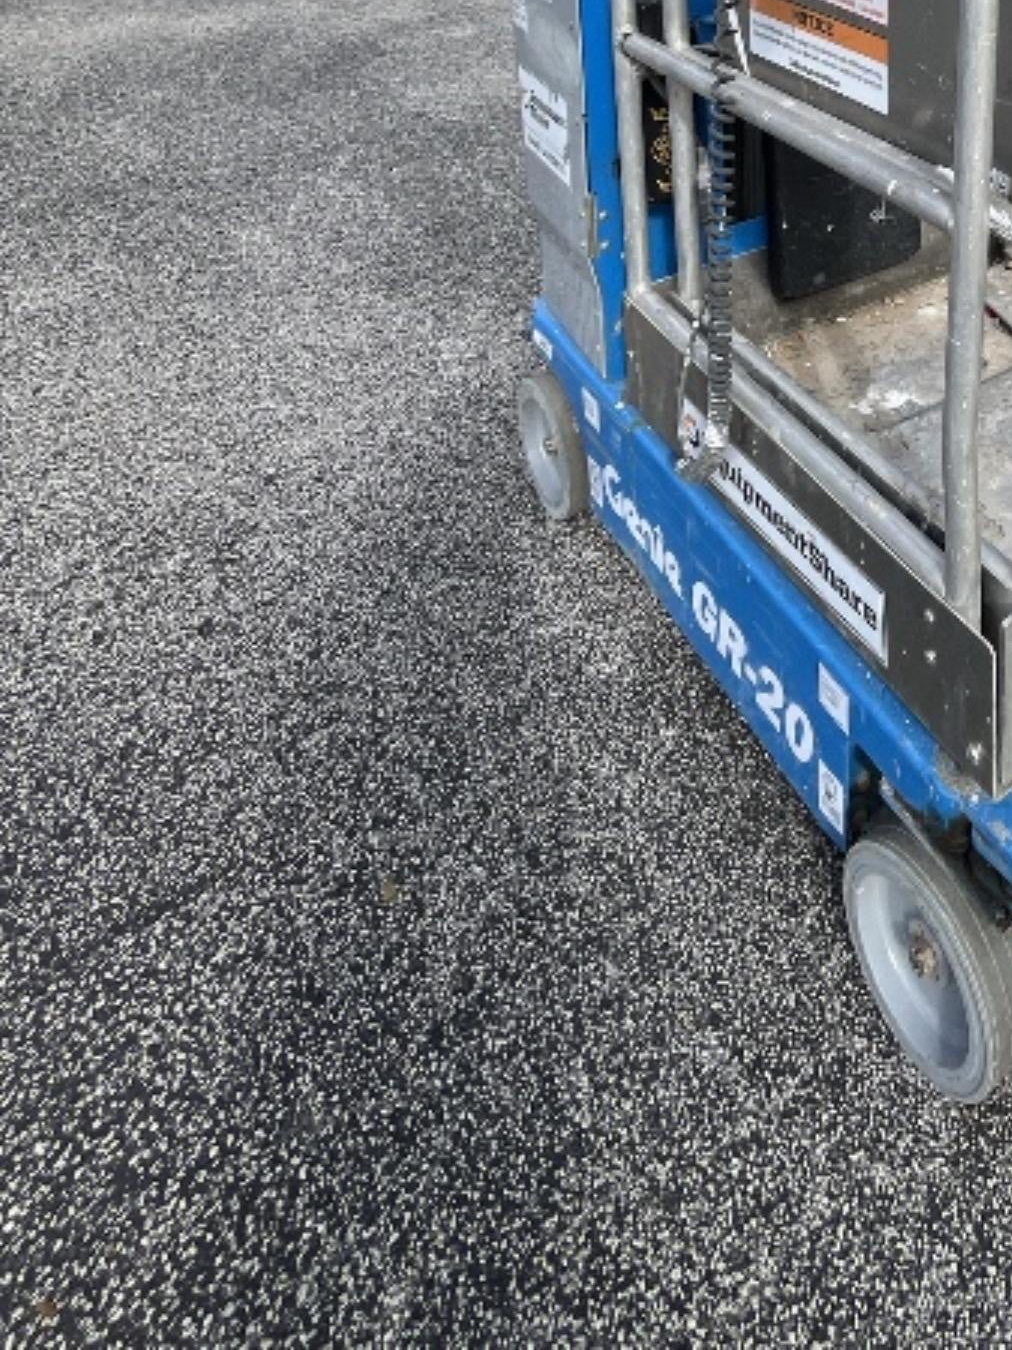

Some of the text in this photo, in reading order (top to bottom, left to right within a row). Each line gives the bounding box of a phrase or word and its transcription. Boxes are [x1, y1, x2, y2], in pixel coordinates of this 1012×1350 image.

[604, 464, 814, 763] Genie GR-20
[717, 457, 878, 631] quipmentShare
